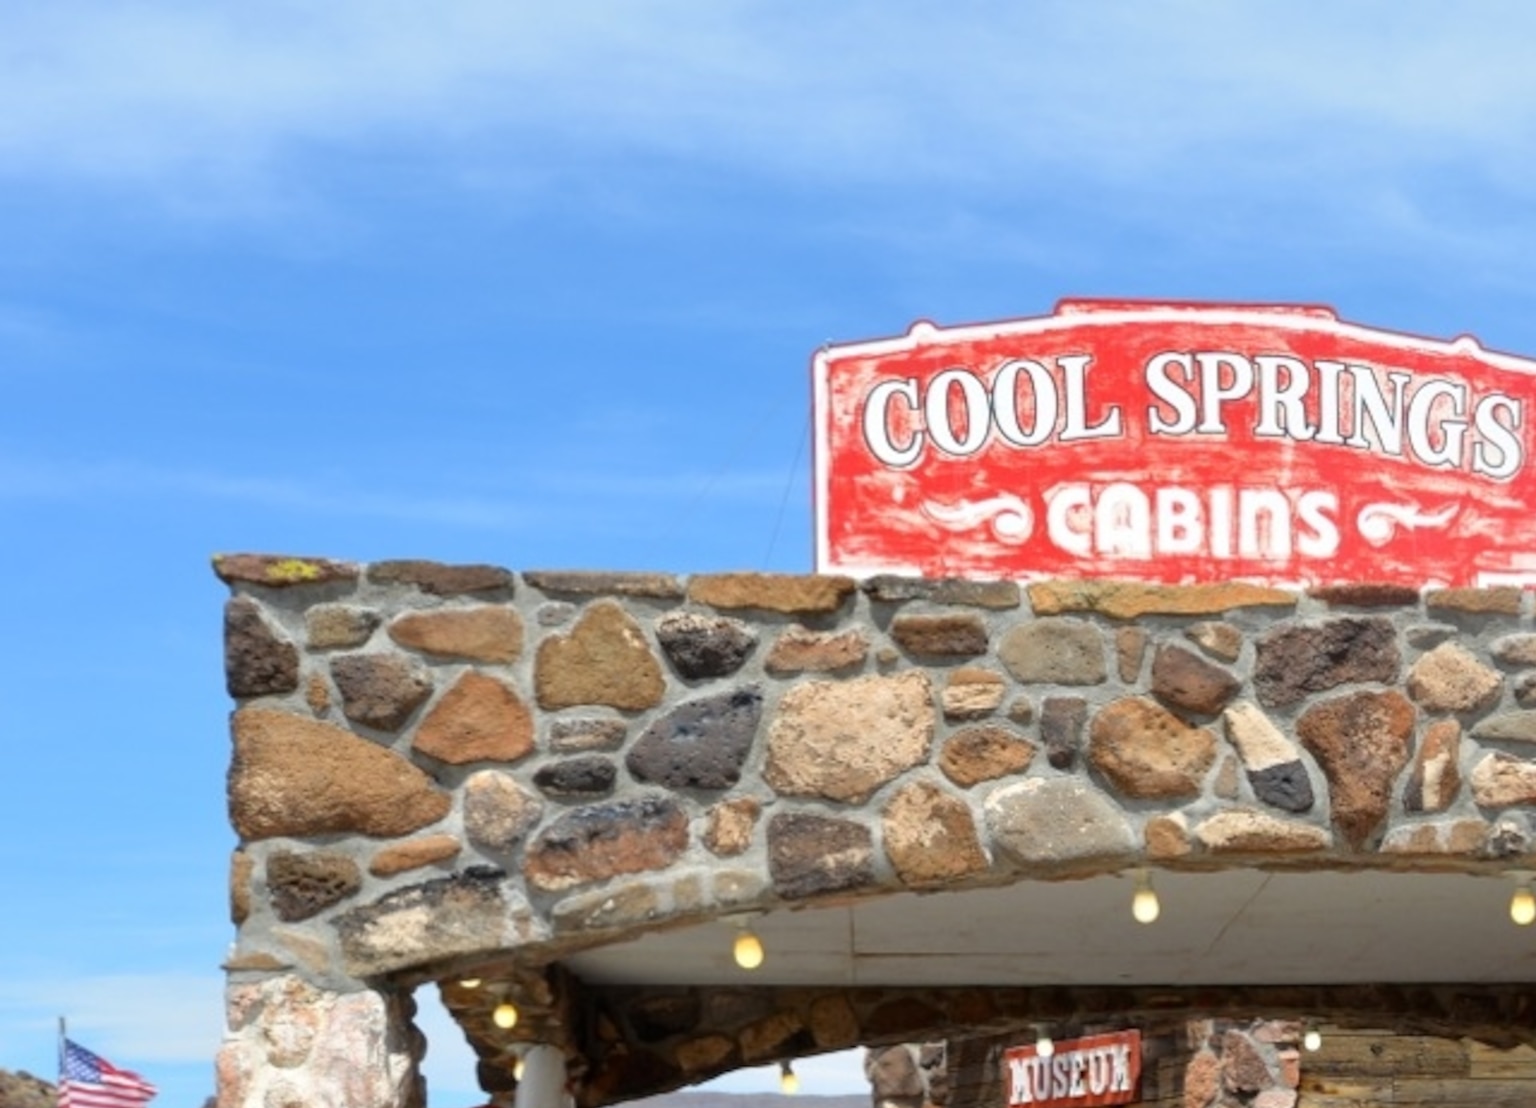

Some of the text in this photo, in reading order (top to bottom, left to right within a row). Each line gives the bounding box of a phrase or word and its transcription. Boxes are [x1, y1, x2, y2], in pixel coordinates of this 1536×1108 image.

[863, 351, 1522, 480] COOL SPRINGS
[1009, 1044, 1130, 1105] MUSEUM
